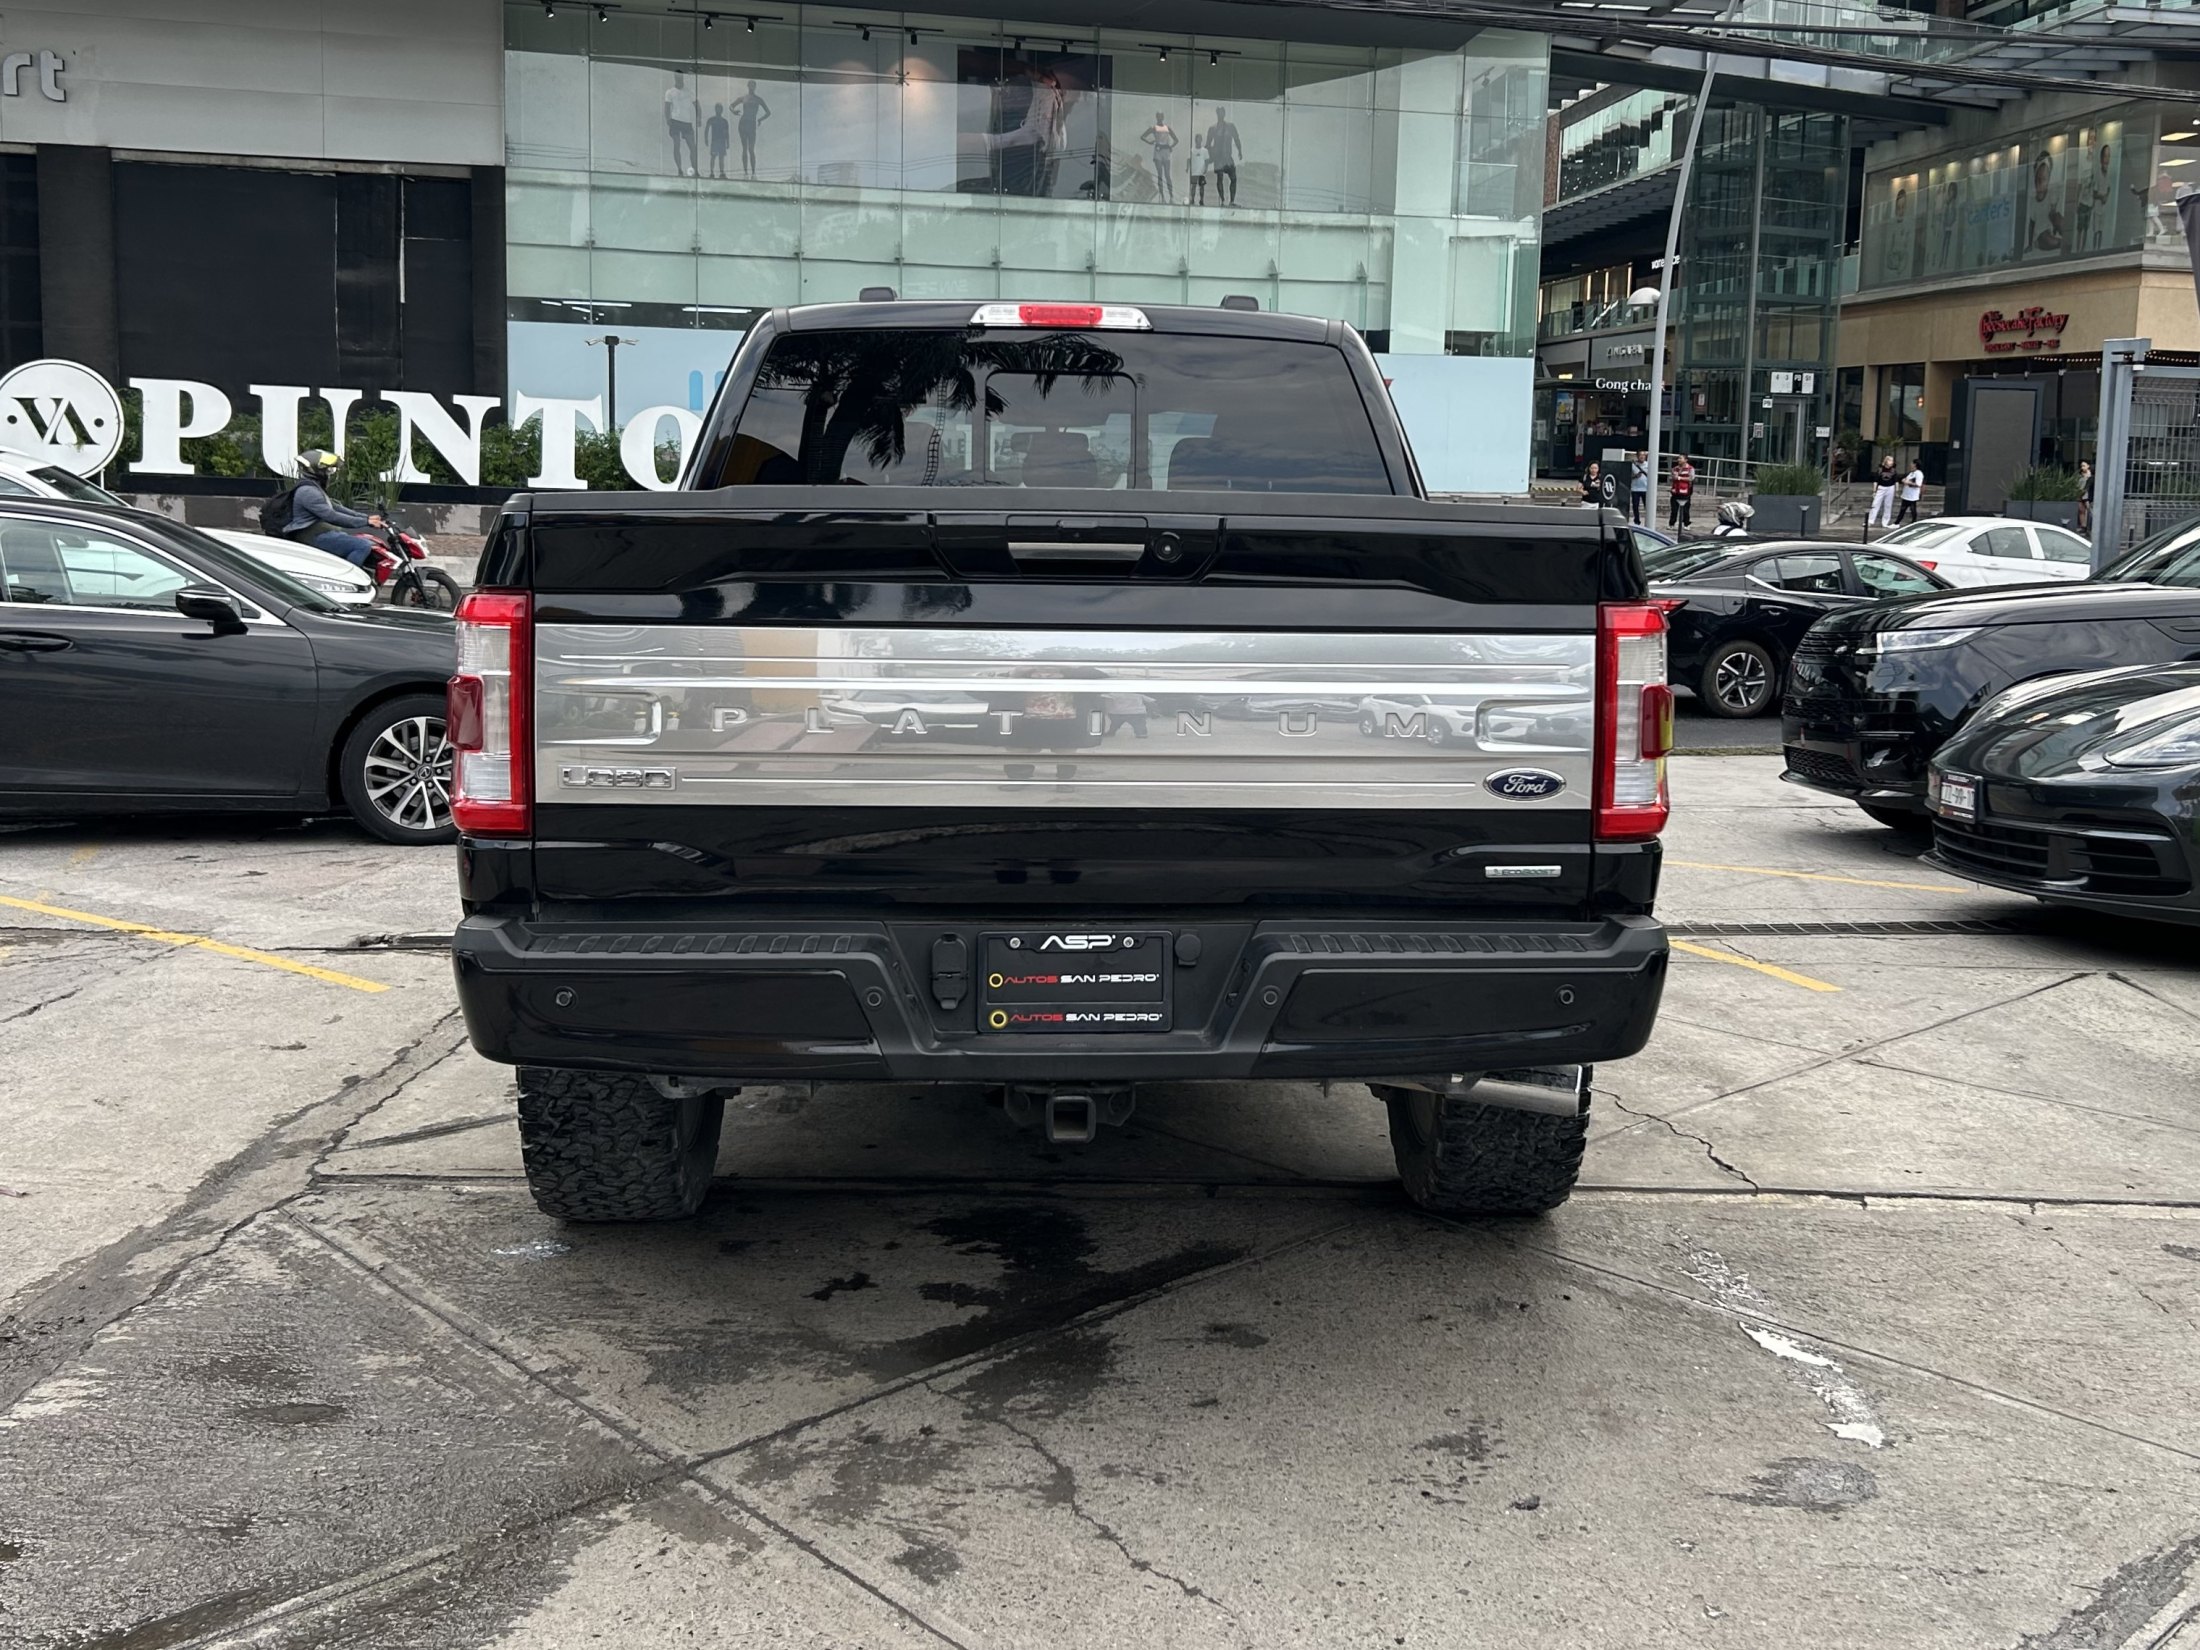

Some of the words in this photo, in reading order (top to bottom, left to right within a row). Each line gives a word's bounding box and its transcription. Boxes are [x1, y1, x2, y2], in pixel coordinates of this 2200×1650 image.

[1595, 378, 1630, 393] Gong
[1630, 379, 1652, 390] cha
[128, 377, 703, 492] PUNTO
[711, 706, 1428, 739] PLATINUM
[1503, 774, 1548, 793] Ford
[1004, 975, 1059, 984] AUTOS
[1060, 974, 1096, 983] SAN
[1010, 1013, 1064, 1022] AUTOS
[1065, 1013, 1100, 1022] SAN
